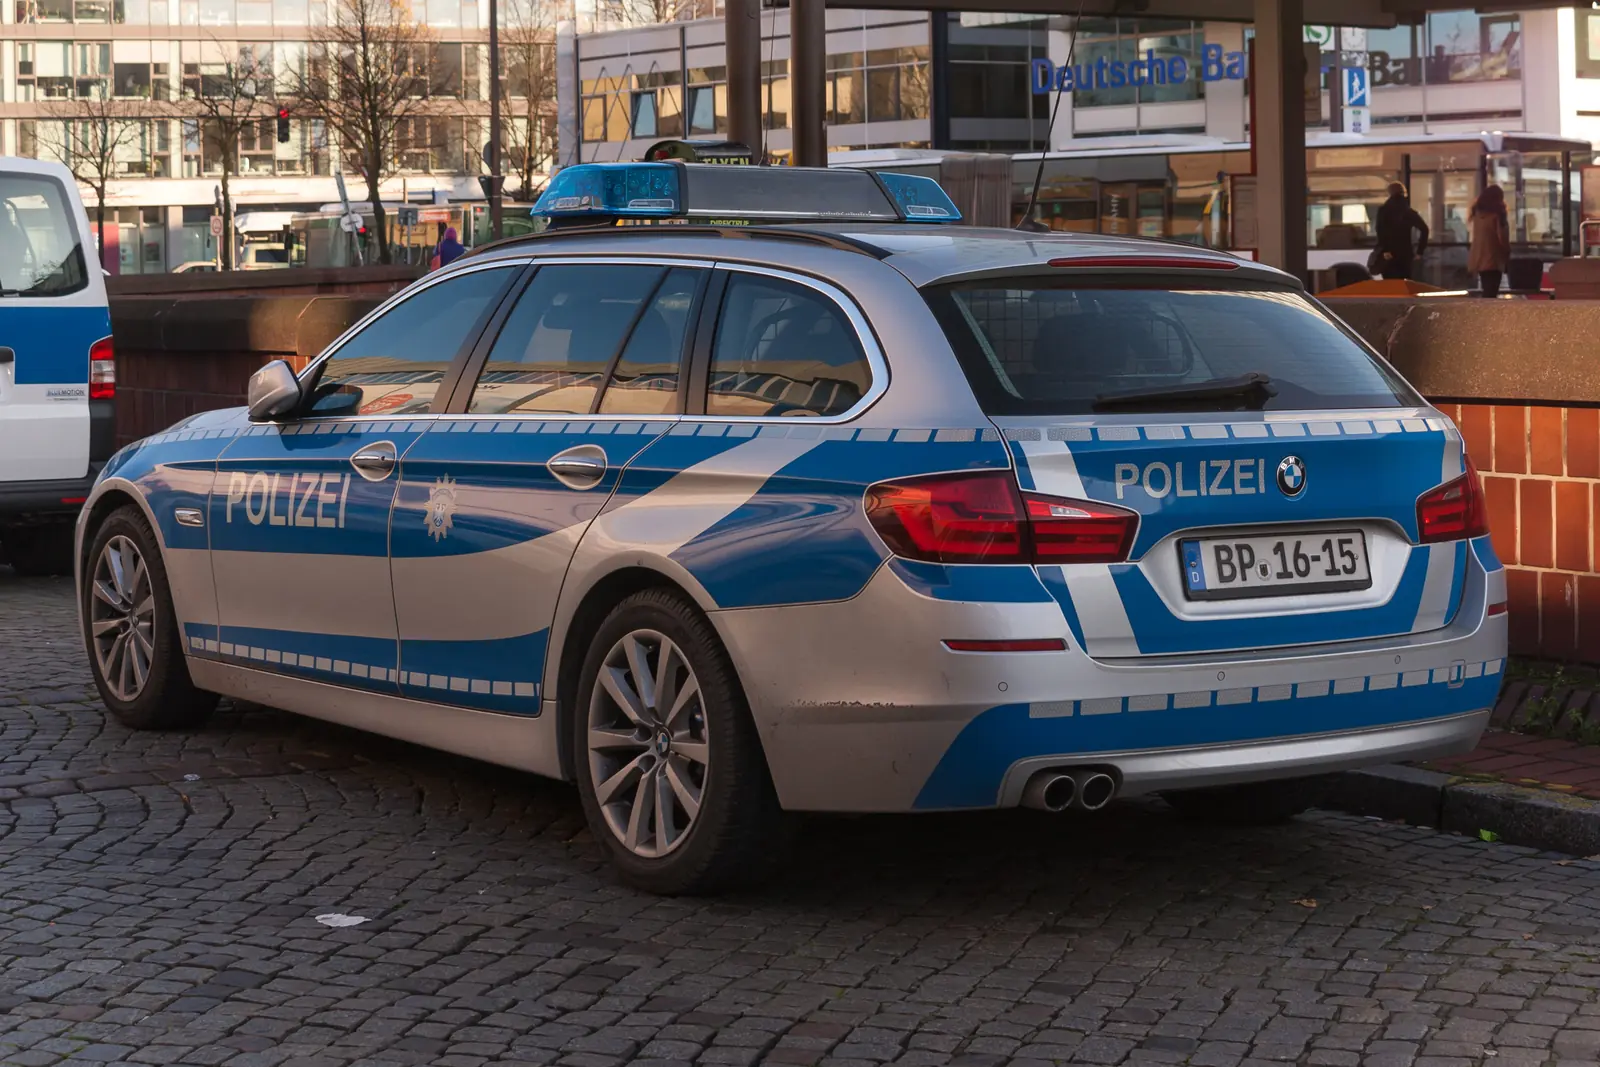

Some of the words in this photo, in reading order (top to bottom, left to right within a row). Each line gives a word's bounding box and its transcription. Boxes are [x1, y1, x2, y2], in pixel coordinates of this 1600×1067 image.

[1031, 49, 1186, 94] Deutsche
[226, 471, 351, 529] POLIZEI
[1114, 458, 1266, 500] POLIZEI
[1191, 571, 1200, 583] D
[1213, 543, 1256, 584] BP
[1272, 538, 1358, 580] 16-15
